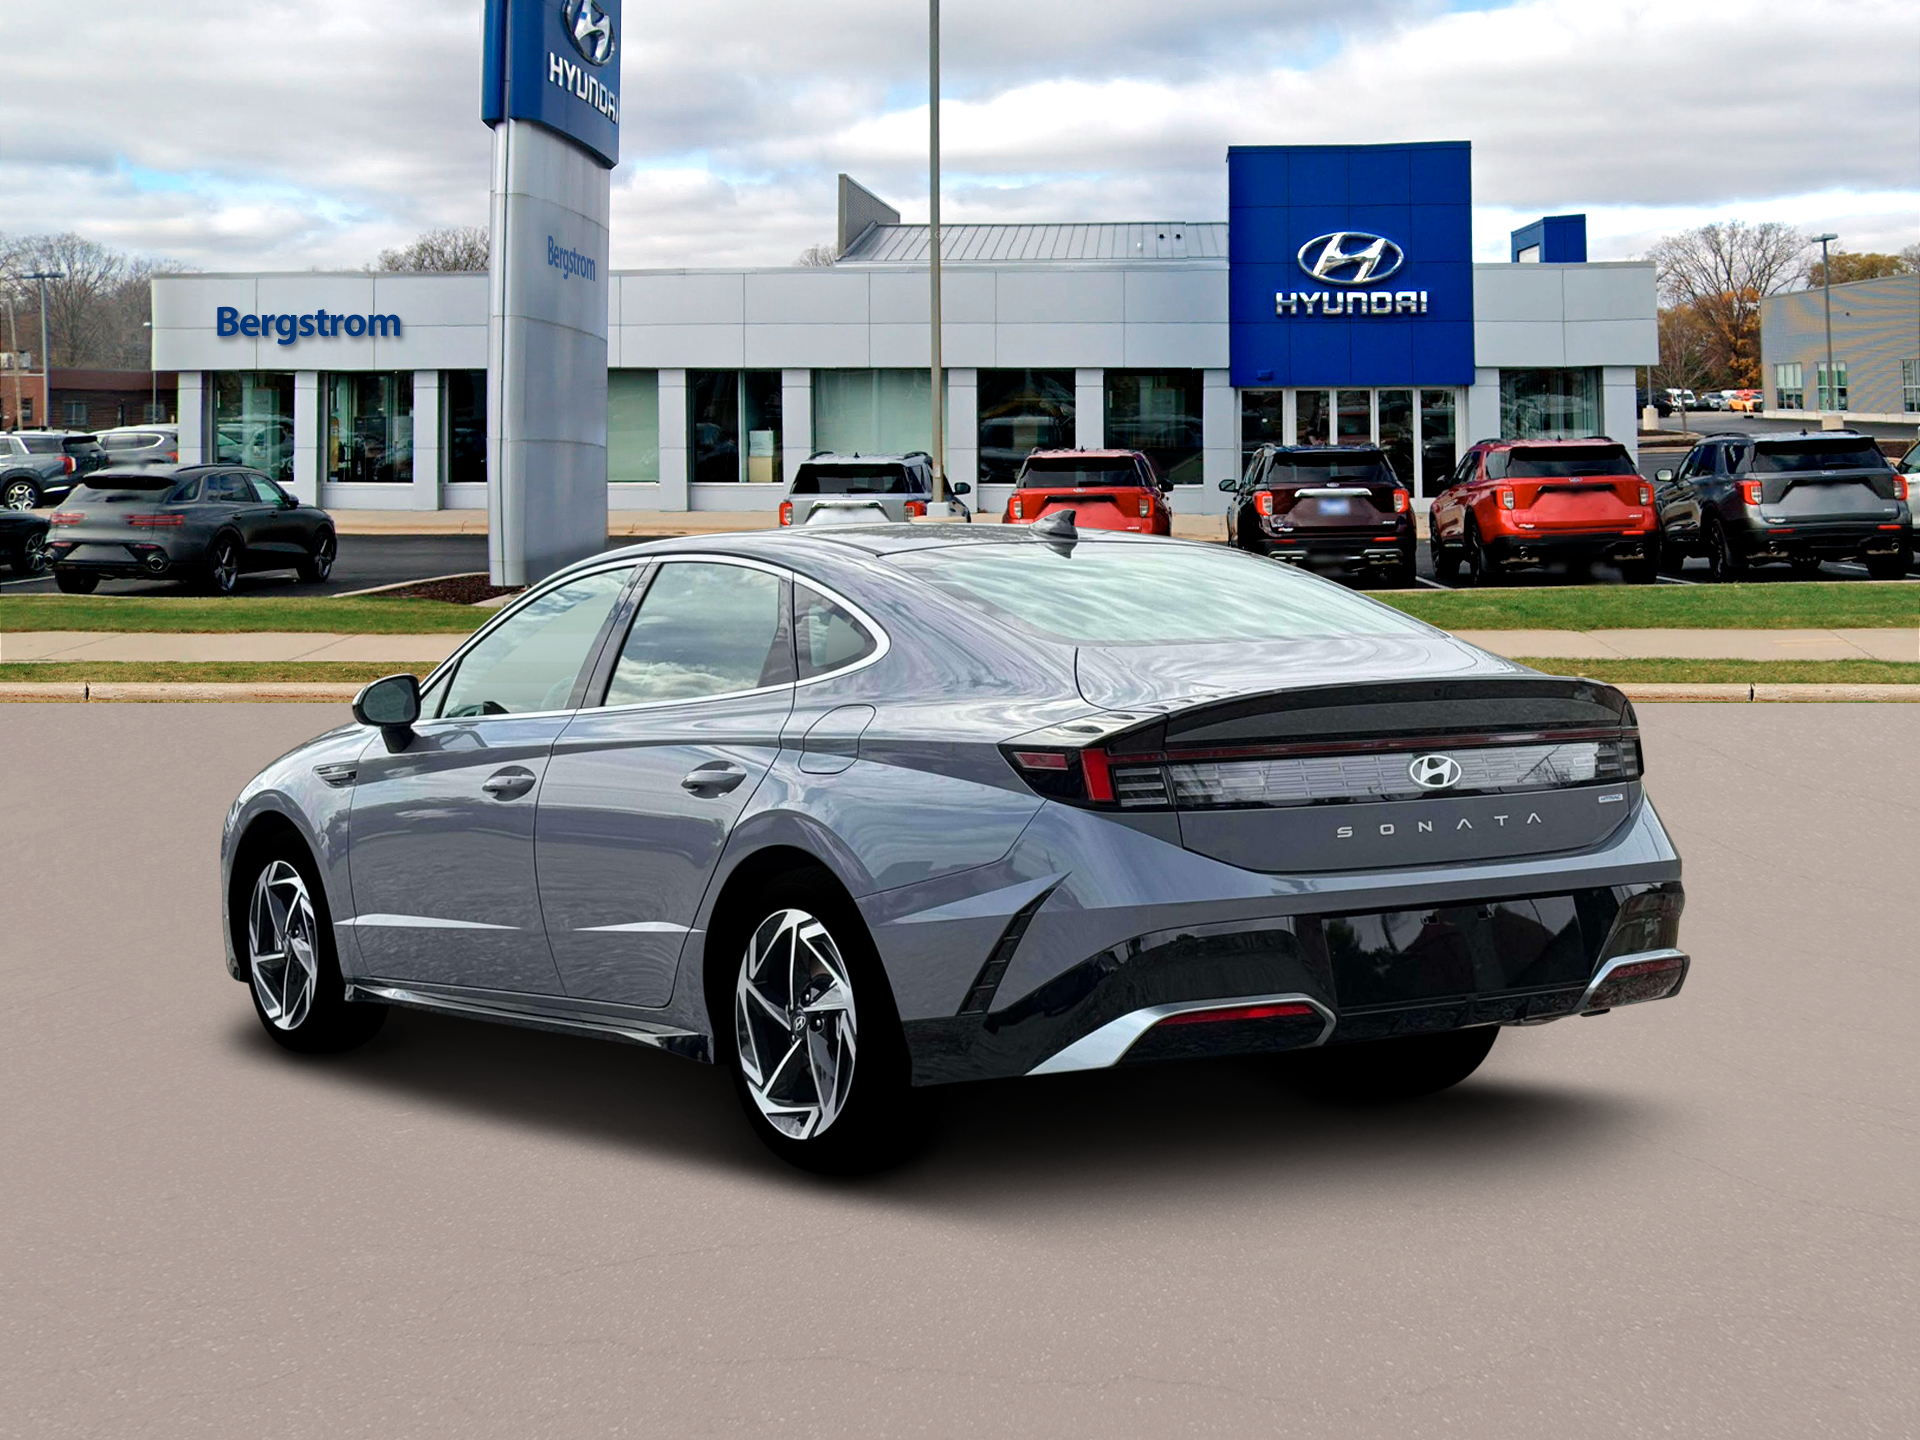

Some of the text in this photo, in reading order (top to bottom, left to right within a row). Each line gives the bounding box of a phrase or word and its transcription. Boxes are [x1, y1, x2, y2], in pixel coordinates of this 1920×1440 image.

[548, 51, 619, 125] HYUNDAI
[547, 235, 596, 282] Bergstrom
[1275, 291, 1428, 315] HYUNDAI
[216, 306, 401, 346] Bergstrom
[1336, 812, 1542, 839] SONATA
